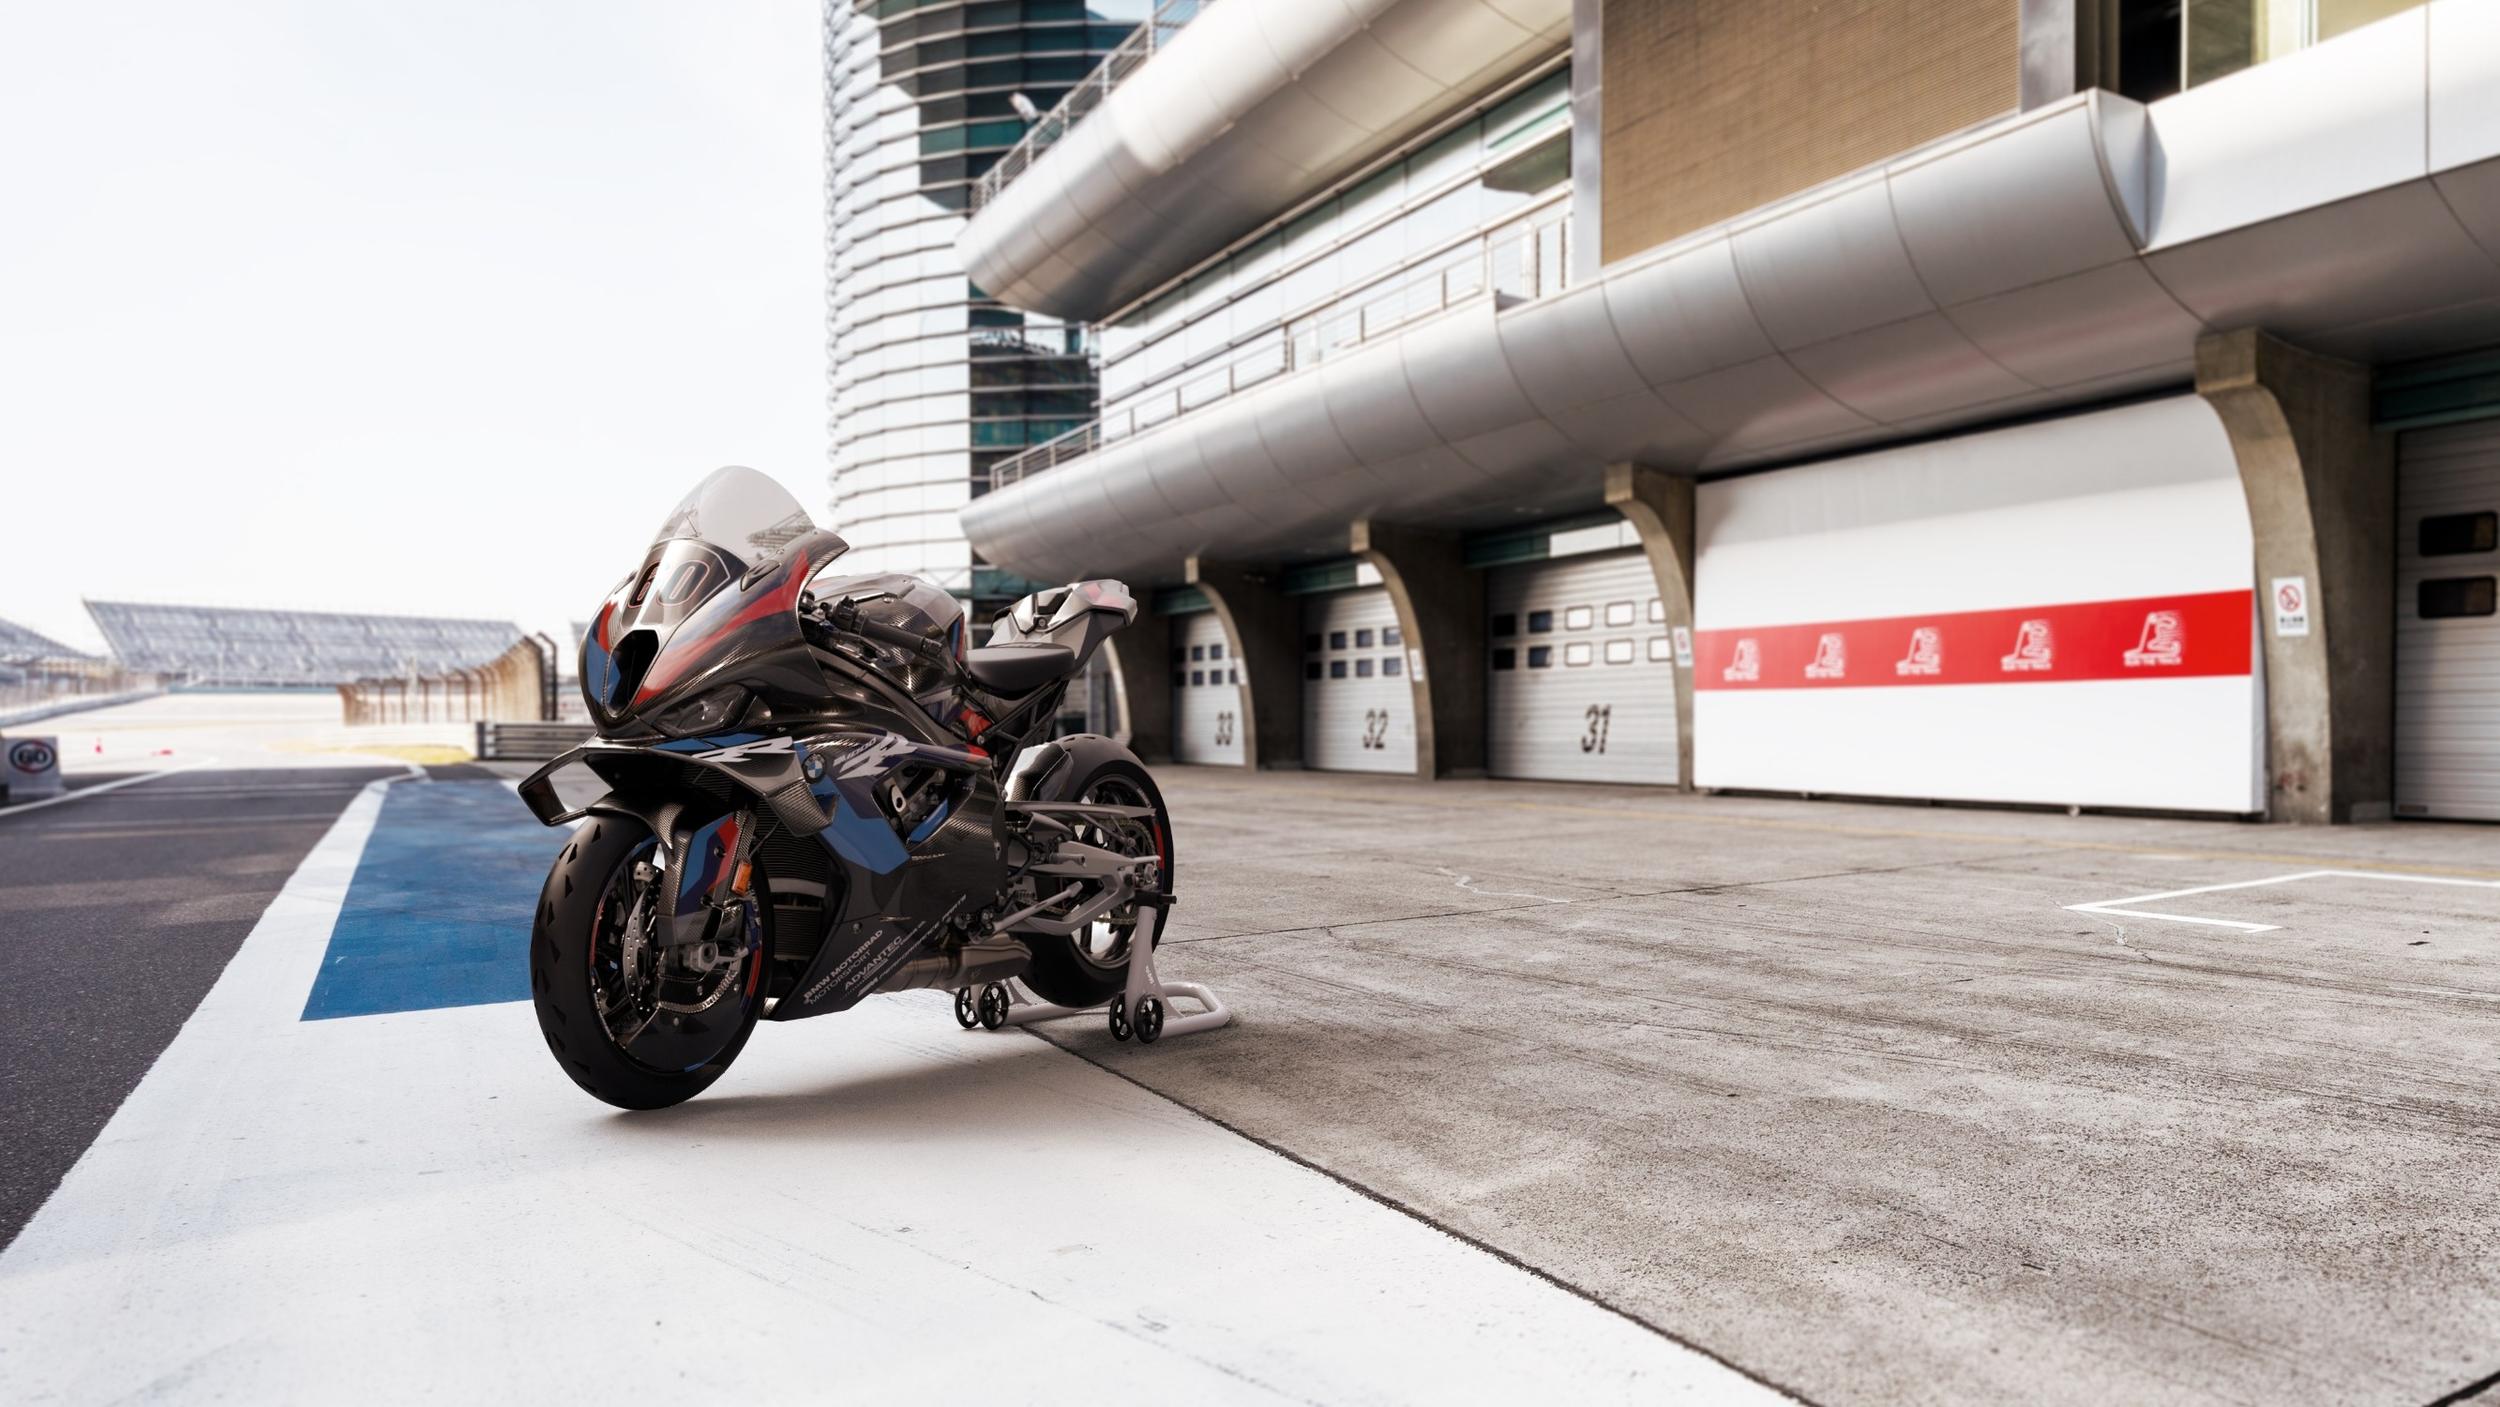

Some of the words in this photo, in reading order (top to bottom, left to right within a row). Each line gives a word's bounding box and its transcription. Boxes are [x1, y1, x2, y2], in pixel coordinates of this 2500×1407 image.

[1215, 710, 1234, 746] 33
[1363, 708, 1389, 750] 32
[1581, 703, 1611, 754] 31
[803, 975, 831, 1001] BMW
[830, 929, 883, 978] MOTORRAD
[810, 950, 872, 1005] MOTORSPORT
[844, 936, 903, 991] ADVANTEC
